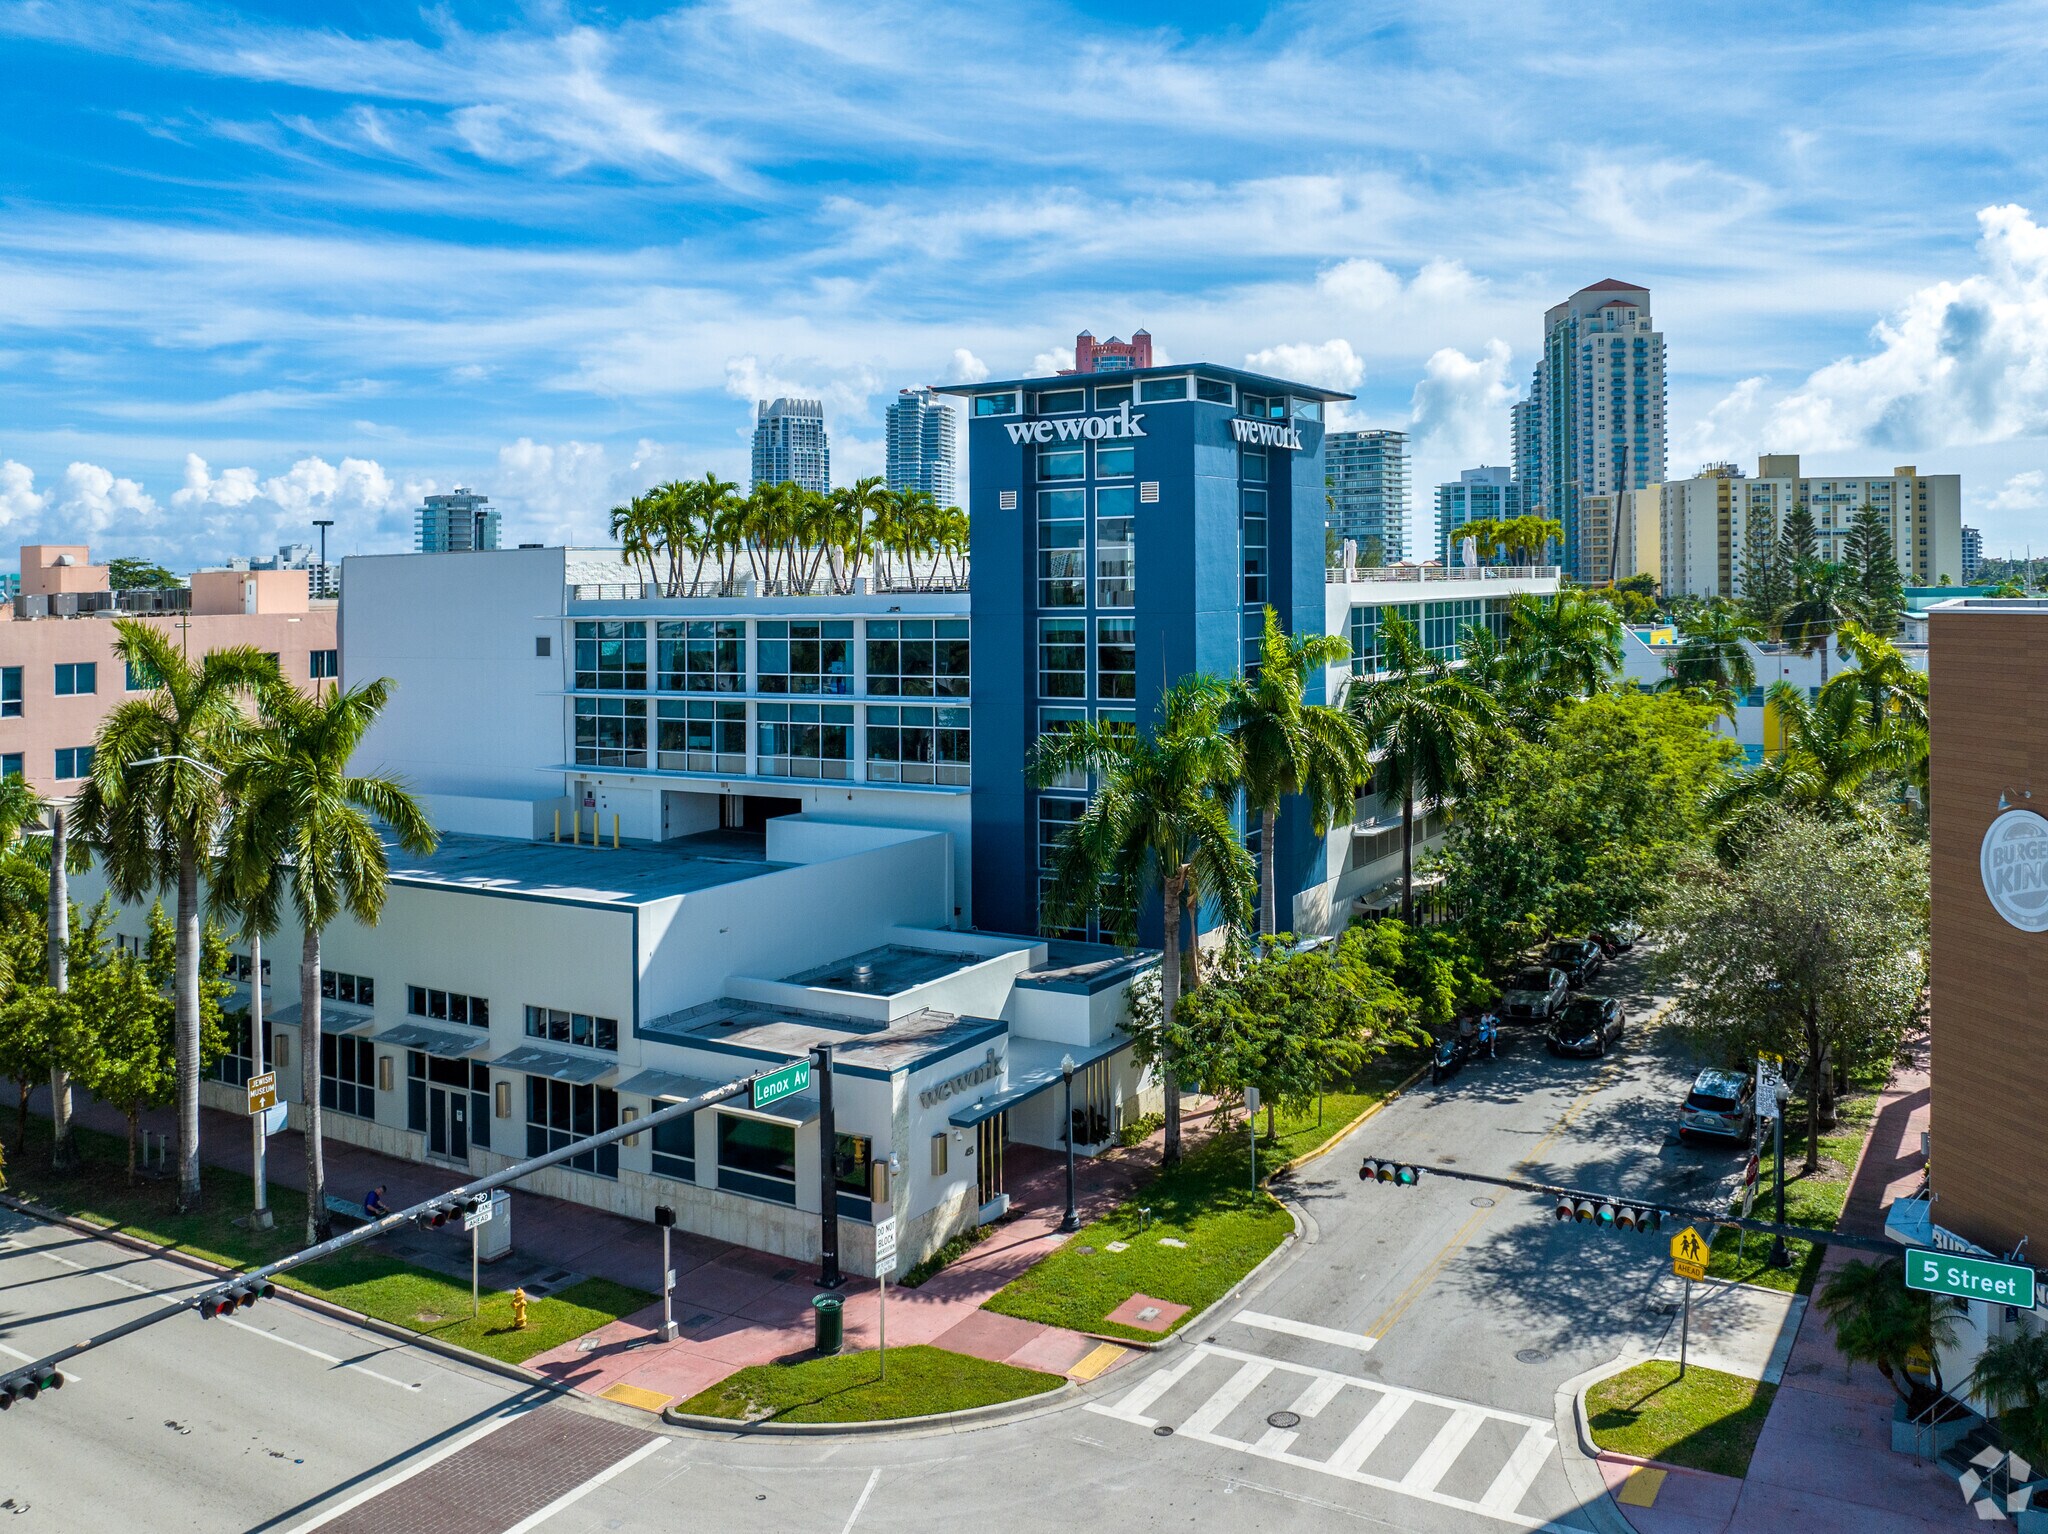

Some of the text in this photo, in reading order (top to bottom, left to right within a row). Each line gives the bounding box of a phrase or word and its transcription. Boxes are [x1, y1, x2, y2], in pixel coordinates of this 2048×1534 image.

[1004, 400, 1148, 444] wework
[1232, 416, 1303, 450] wework
[252, 1075, 273, 1088] JEWISH
[757, 1070, 807, 1101] Lenox Av
[919, 1048, 1004, 1109] wework
[250, 1084, 275, 1098] MUSEUM
[469, 1213, 489, 1228] AHEAD
[877, 1221, 895, 1237] DO NOT
[878, 1234, 894, 1249] BLOCK
[1678, 1264, 1700, 1277] AHEAD
[1923, 1260, 1939, 1282] 5
[1947, 1267, 2016, 1297] Street
